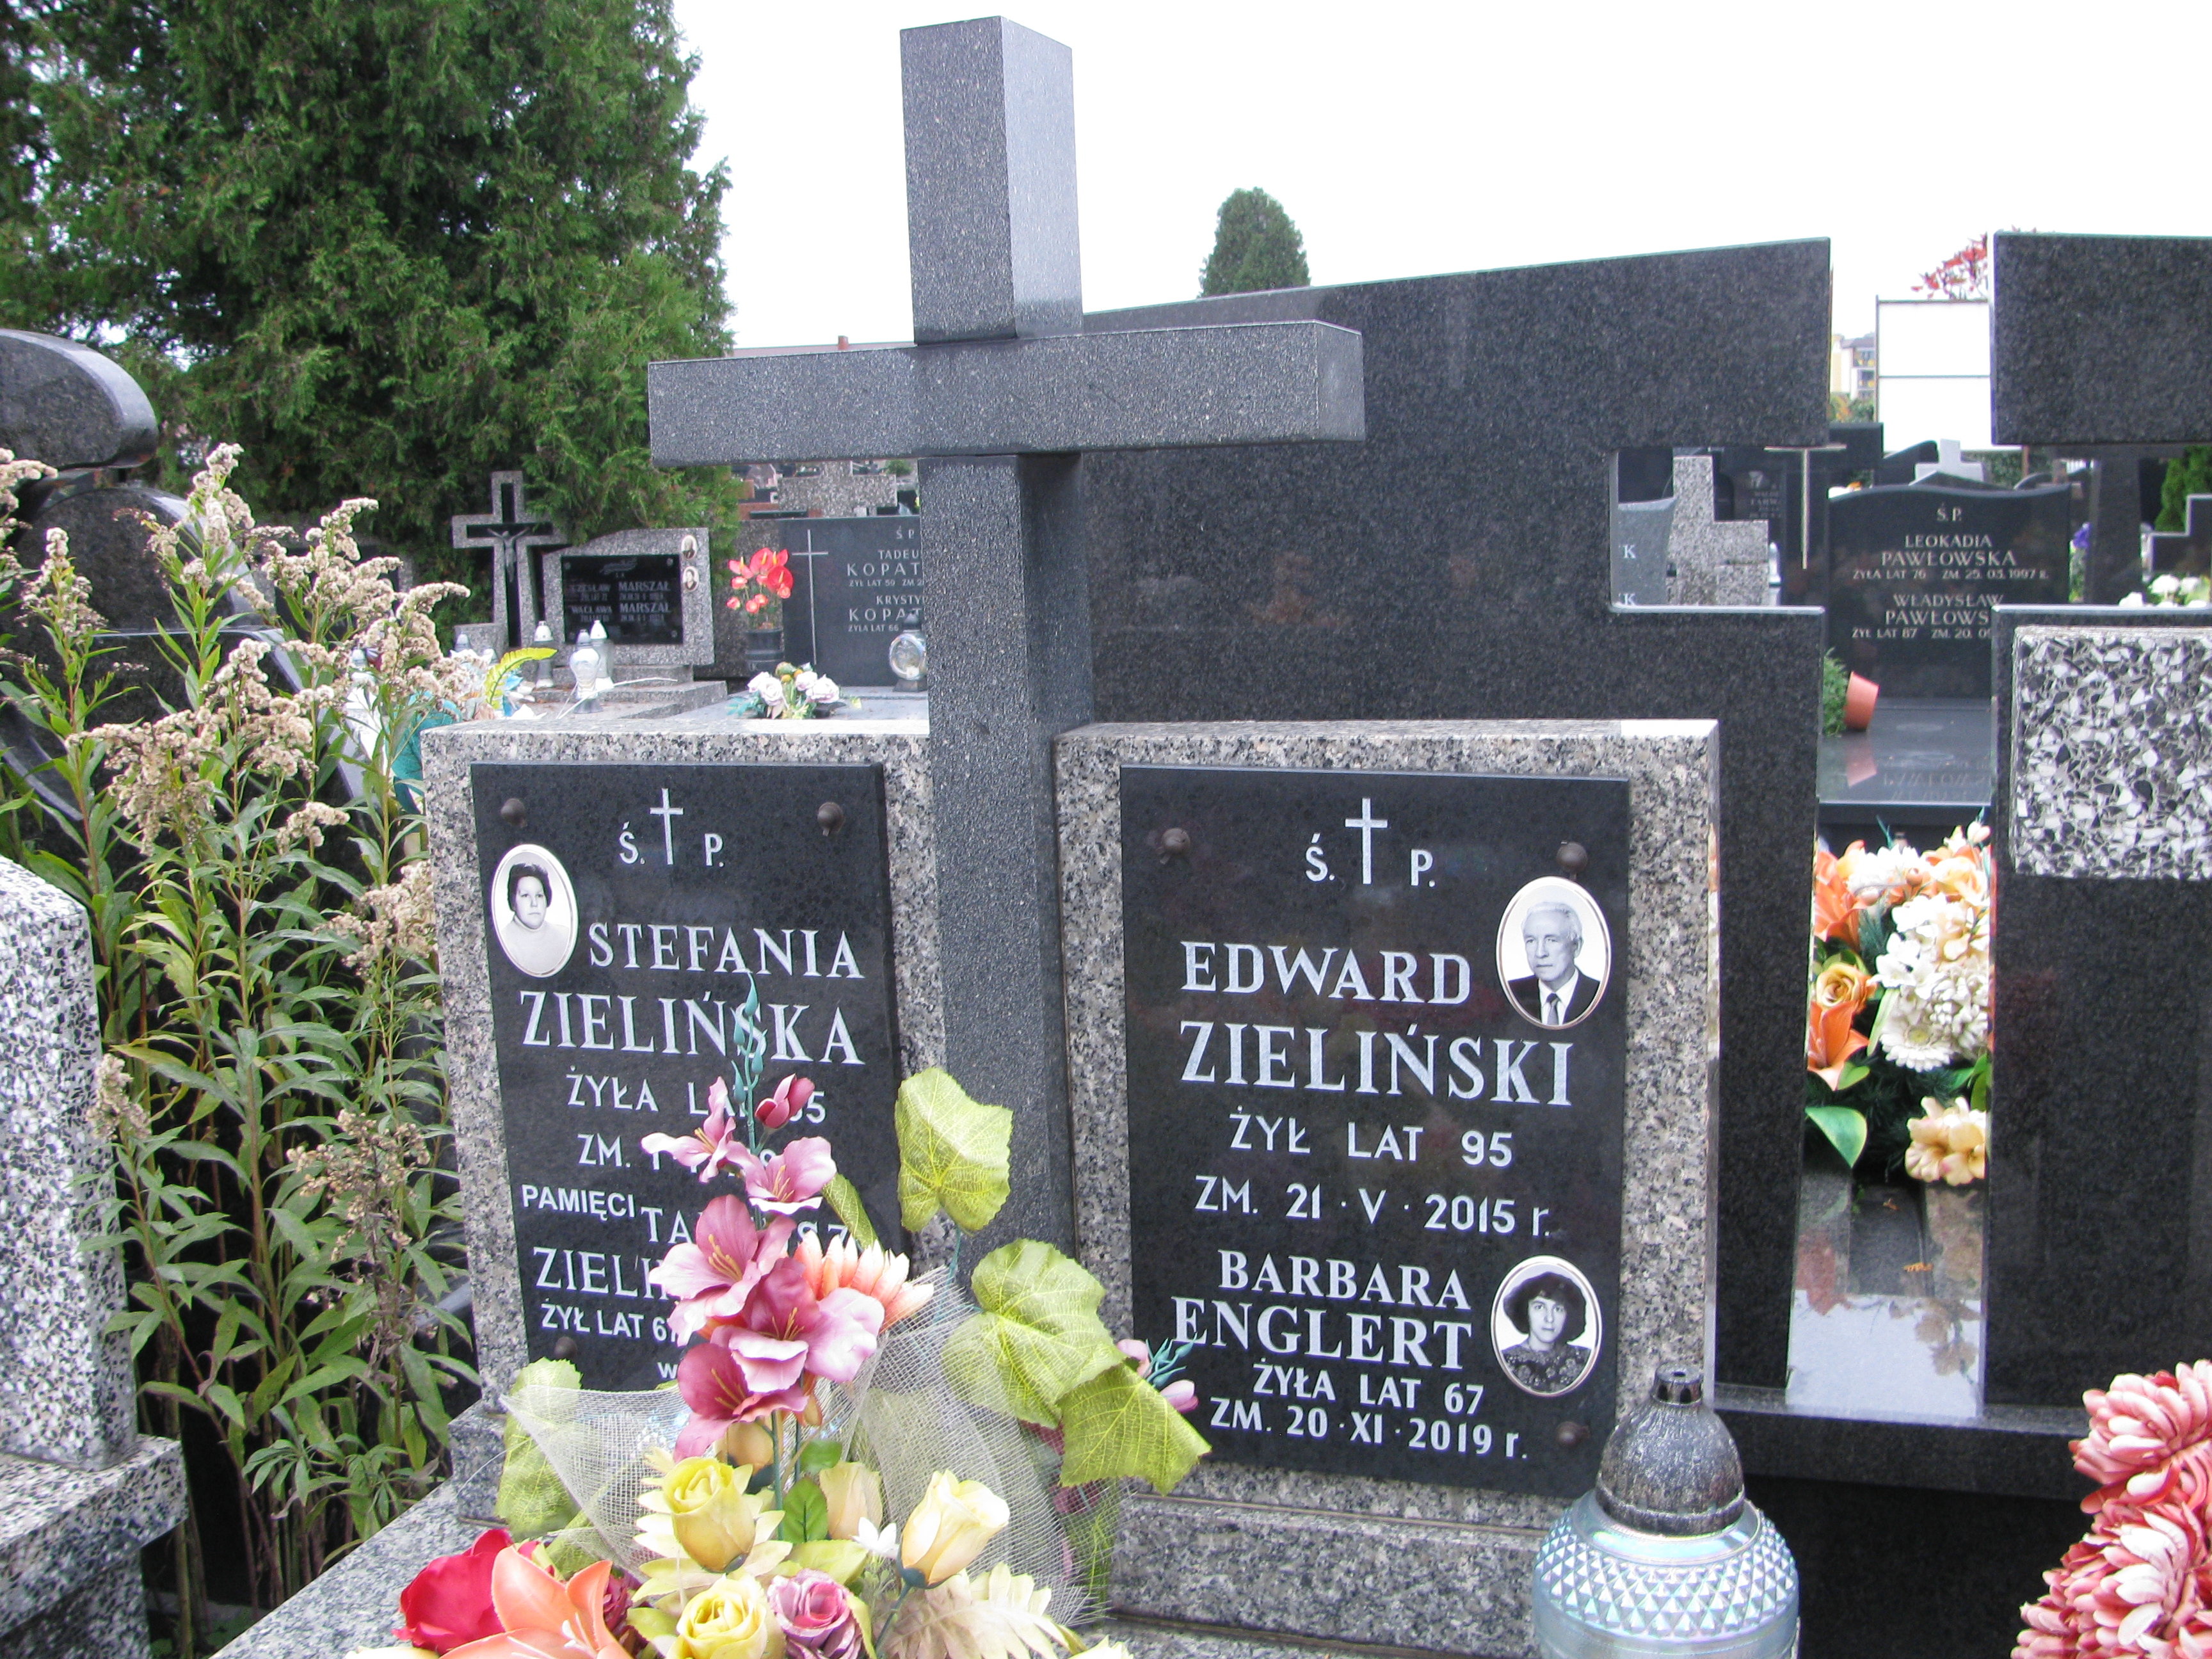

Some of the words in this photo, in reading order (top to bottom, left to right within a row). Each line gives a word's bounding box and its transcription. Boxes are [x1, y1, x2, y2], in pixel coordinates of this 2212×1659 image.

[1882, 550, 2017, 566] PAWŁOWSKA
[1905, 534, 1992, 548] LEOKADIA
[847, 563, 920, 577] KOPAT
[1886, 569, 1907, 579] LAT
[1893, 593, 2004, 607] WŁADYSŁAW
[1877, 628, 1897, 638] LAT
[620, 822, 645, 864] Ś.
[705, 833, 723, 867] P.
[1306, 833, 1334, 881] Ś.
[1411, 849, 1435, 886] P.
[589, 922, 865, 979] STEFANIA
[1181, 942, 1470, 1004] EDWARD
[520, 991, 865, 1065] ZIELIŃSKA
[1181, 1021, 1573, 1105] ZIELIŃSKI
[566, 1066, 658, 1111] ŻYŁA
[578, 1134, 630, 1167] ZM.
[1230, 1106, 1310, 1153] ŻYŁ
[1349, 1123, 1423, 1161] LAT
[1462, 1131, 1511, 1166] 95
[522, 1185, 634, 1221] PAMIĘCI
[1196, 1175, 1258, 1214] ZM.
[1286, 1183, 1320, 1219] 21
[1359, 1189, 1386, 1223] V
[1425, 1194, 1514, 1233] 2015
[1533, 1208, 1549, 1236] r.
[1218, 1250, 1471, 1310] BARBARA
[541, 1298, 590, 1332] ŻYŁ
[597, 1310, 644, 1338] LAT
[1171, 1297, 1471, 1370] ENGLERT
[1253, 1358, 1336, 1400] ŻYŁA
[1360, 1374, 1421, 1408] LAT
[1445, 1383, 1483, 1414] 67
[1210, 1397, 1271, 1431] ZM.
[1287, 1406, 1327, 1437] 20
[1350, 1412, 1382, 1443] XI
[1409, 1418, 1491, 1454] 2019
[1506, 1433, 1527, 1458] r.
